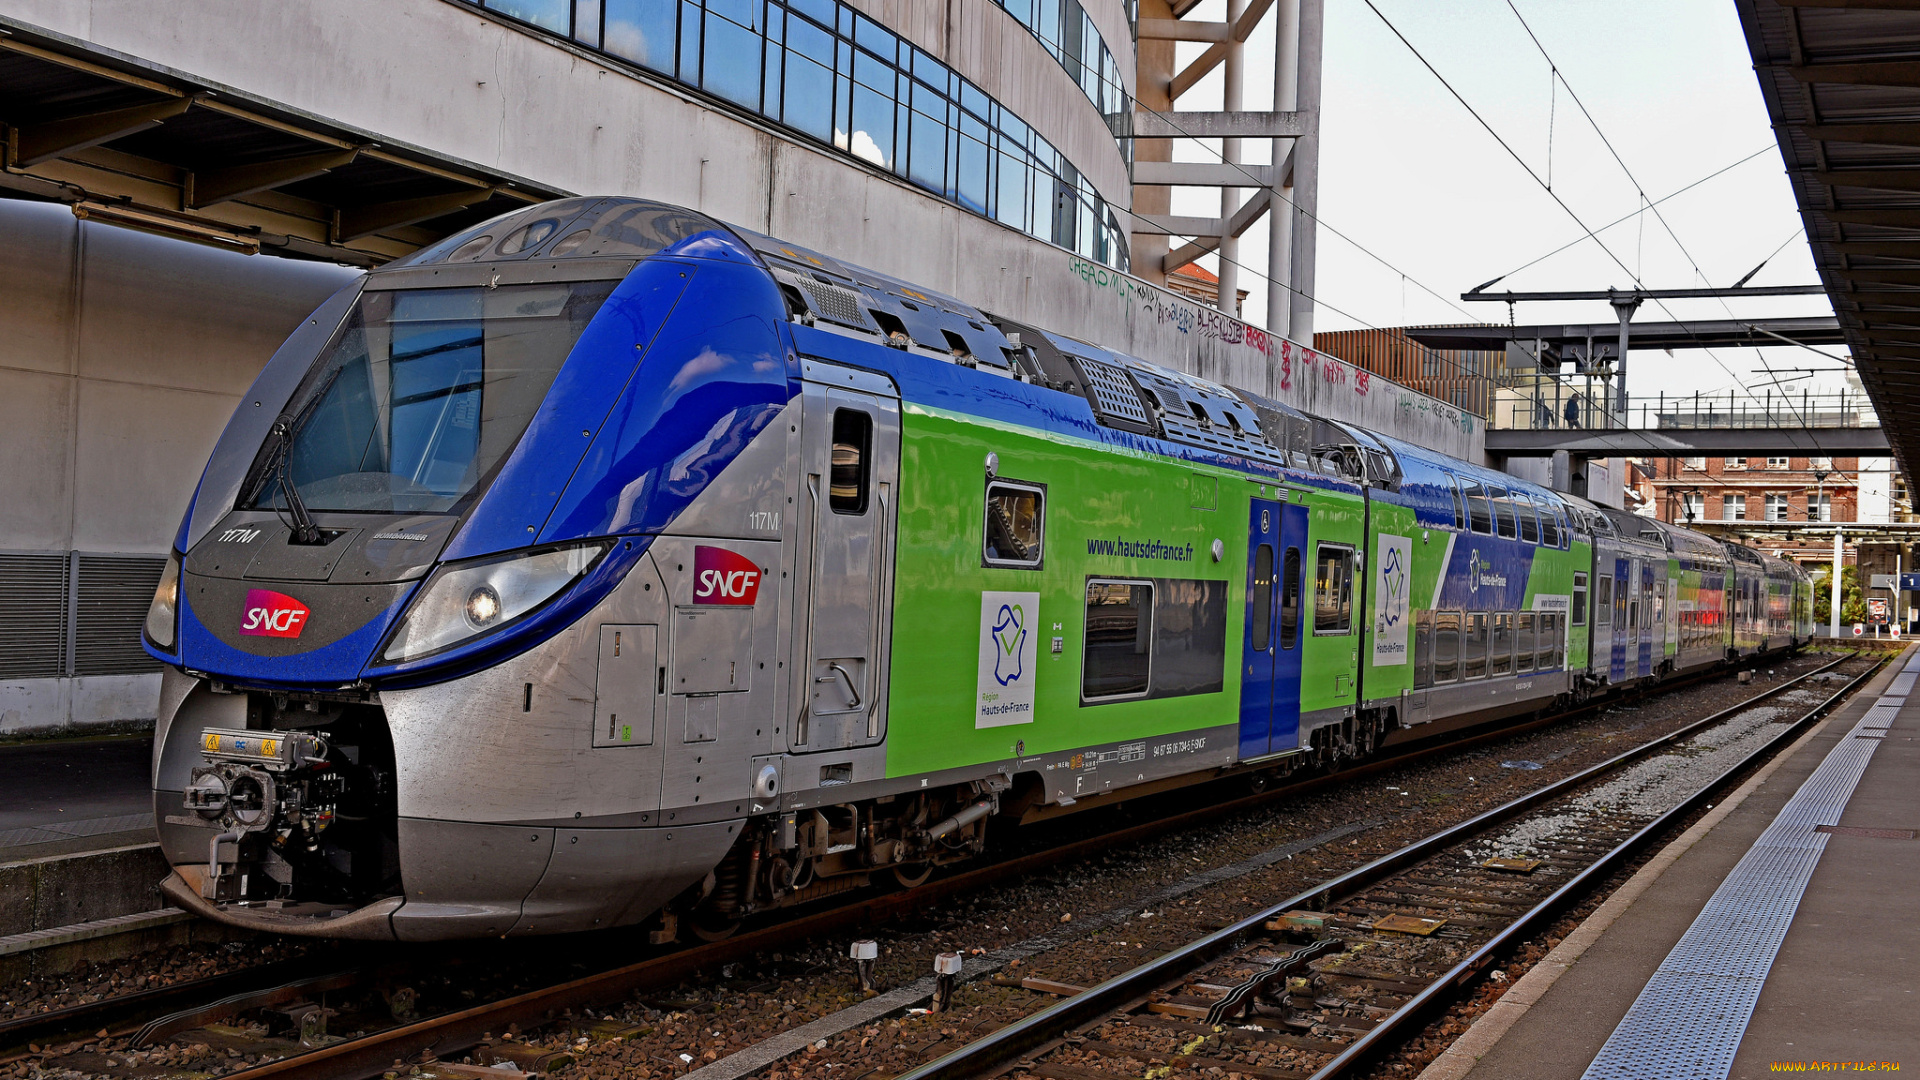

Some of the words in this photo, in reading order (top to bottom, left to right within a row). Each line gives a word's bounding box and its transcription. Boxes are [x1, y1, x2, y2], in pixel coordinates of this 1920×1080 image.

[749, 511, 779, 530] 117M
[218, 529, 261, 544] 117M
[373, 533, 428, 541] BOMBARDIER
[1087, 536, 1193, 561] www.hautsdefrance.fr
[696, 569, 758, 598] SNCF
[1909, 578, 1914, 586] 1
[242, 607, 305, 631] SNCF
[982, 692, 999, 703] Région
[981, 702, 1030, 716] Hauts-de-France
[1076, 776, 1083, 793] F
